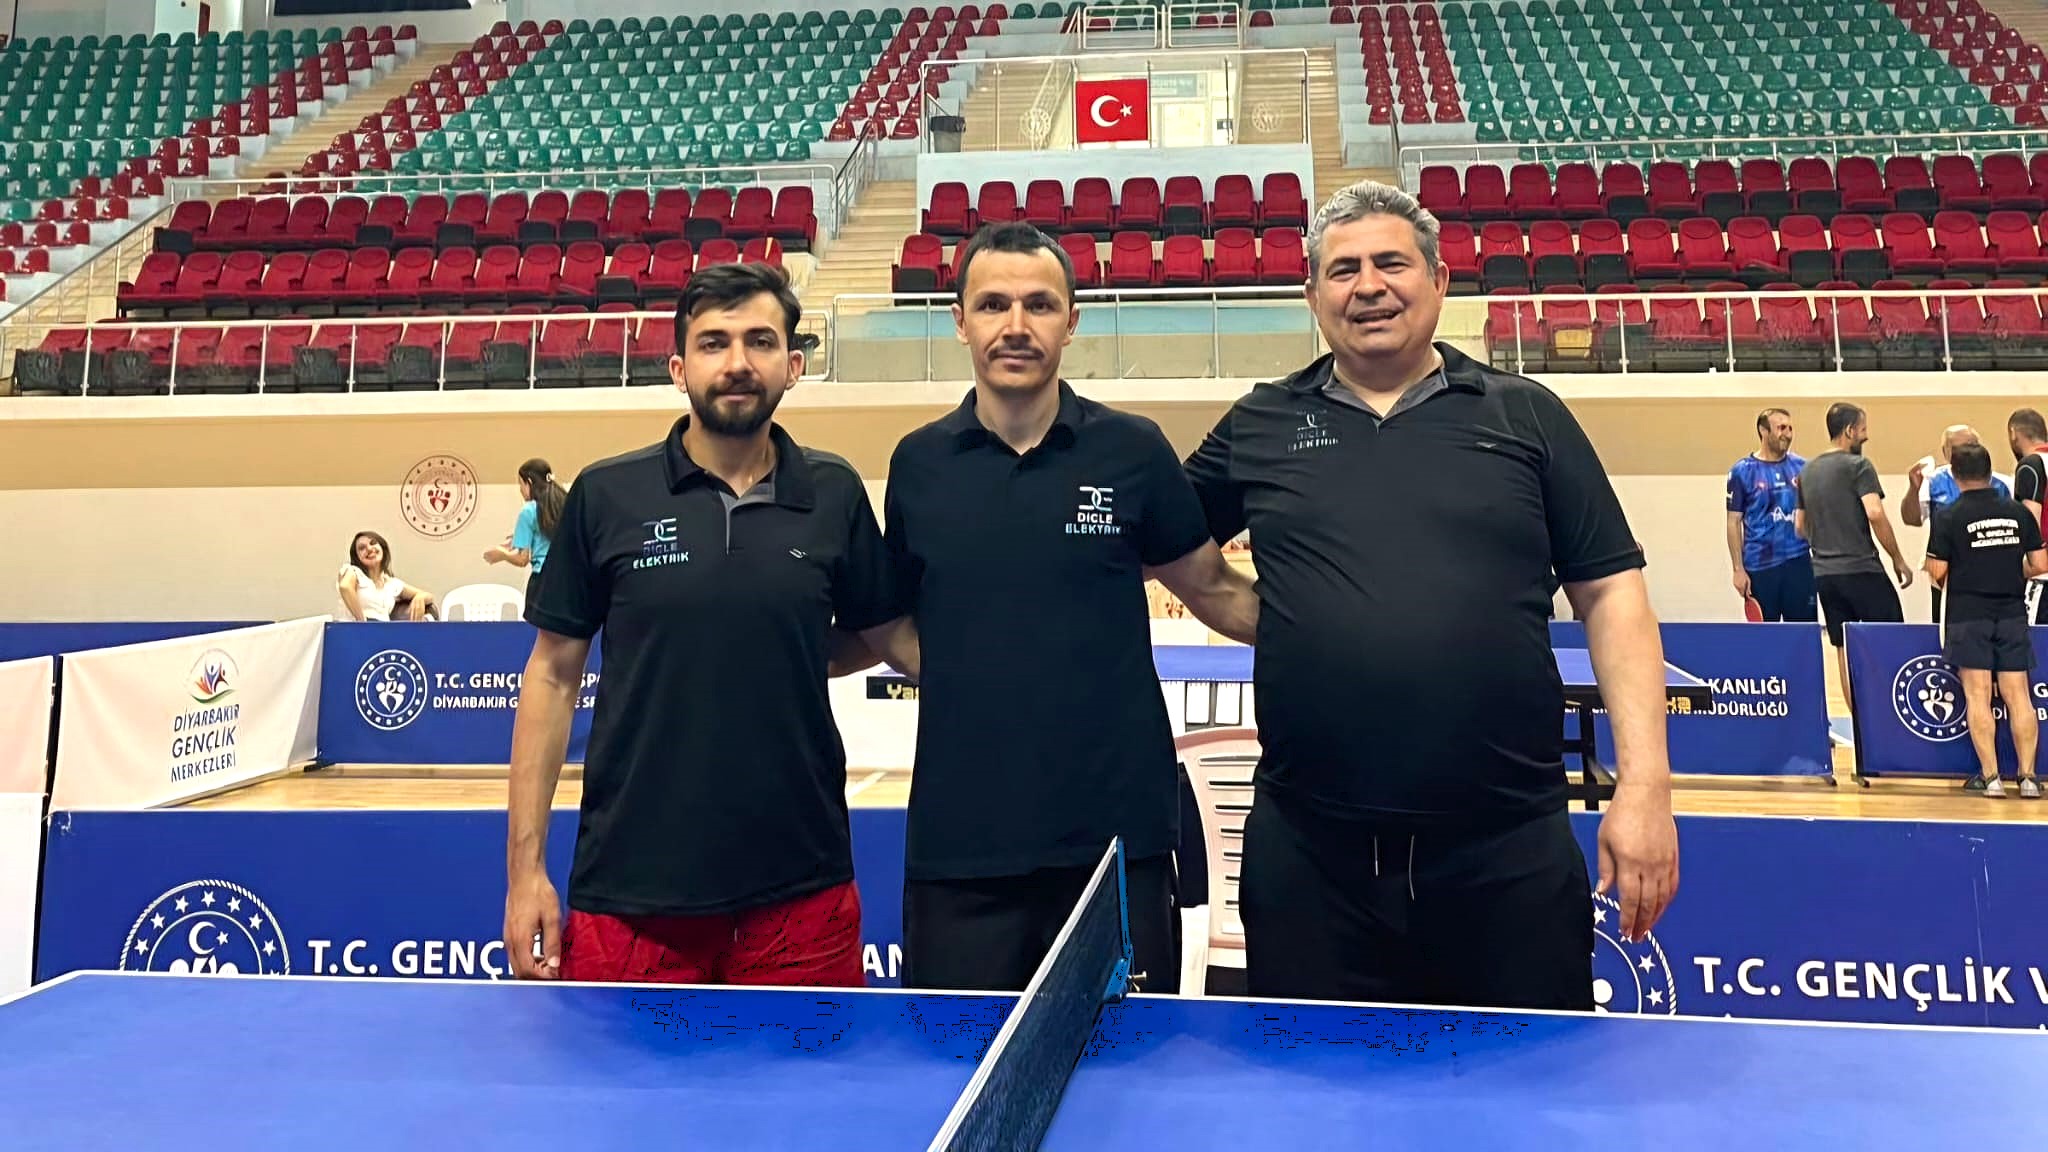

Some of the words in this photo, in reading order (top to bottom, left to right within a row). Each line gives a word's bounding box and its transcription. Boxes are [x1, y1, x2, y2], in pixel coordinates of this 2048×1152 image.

[1708, 676, 1787, 695] KANLIĞI
[307, 940, 378, 974] T.C.
[1694, 956, 1781, 996] T.C.
[1796, 957, 2015, 1012] GENÇLİK
